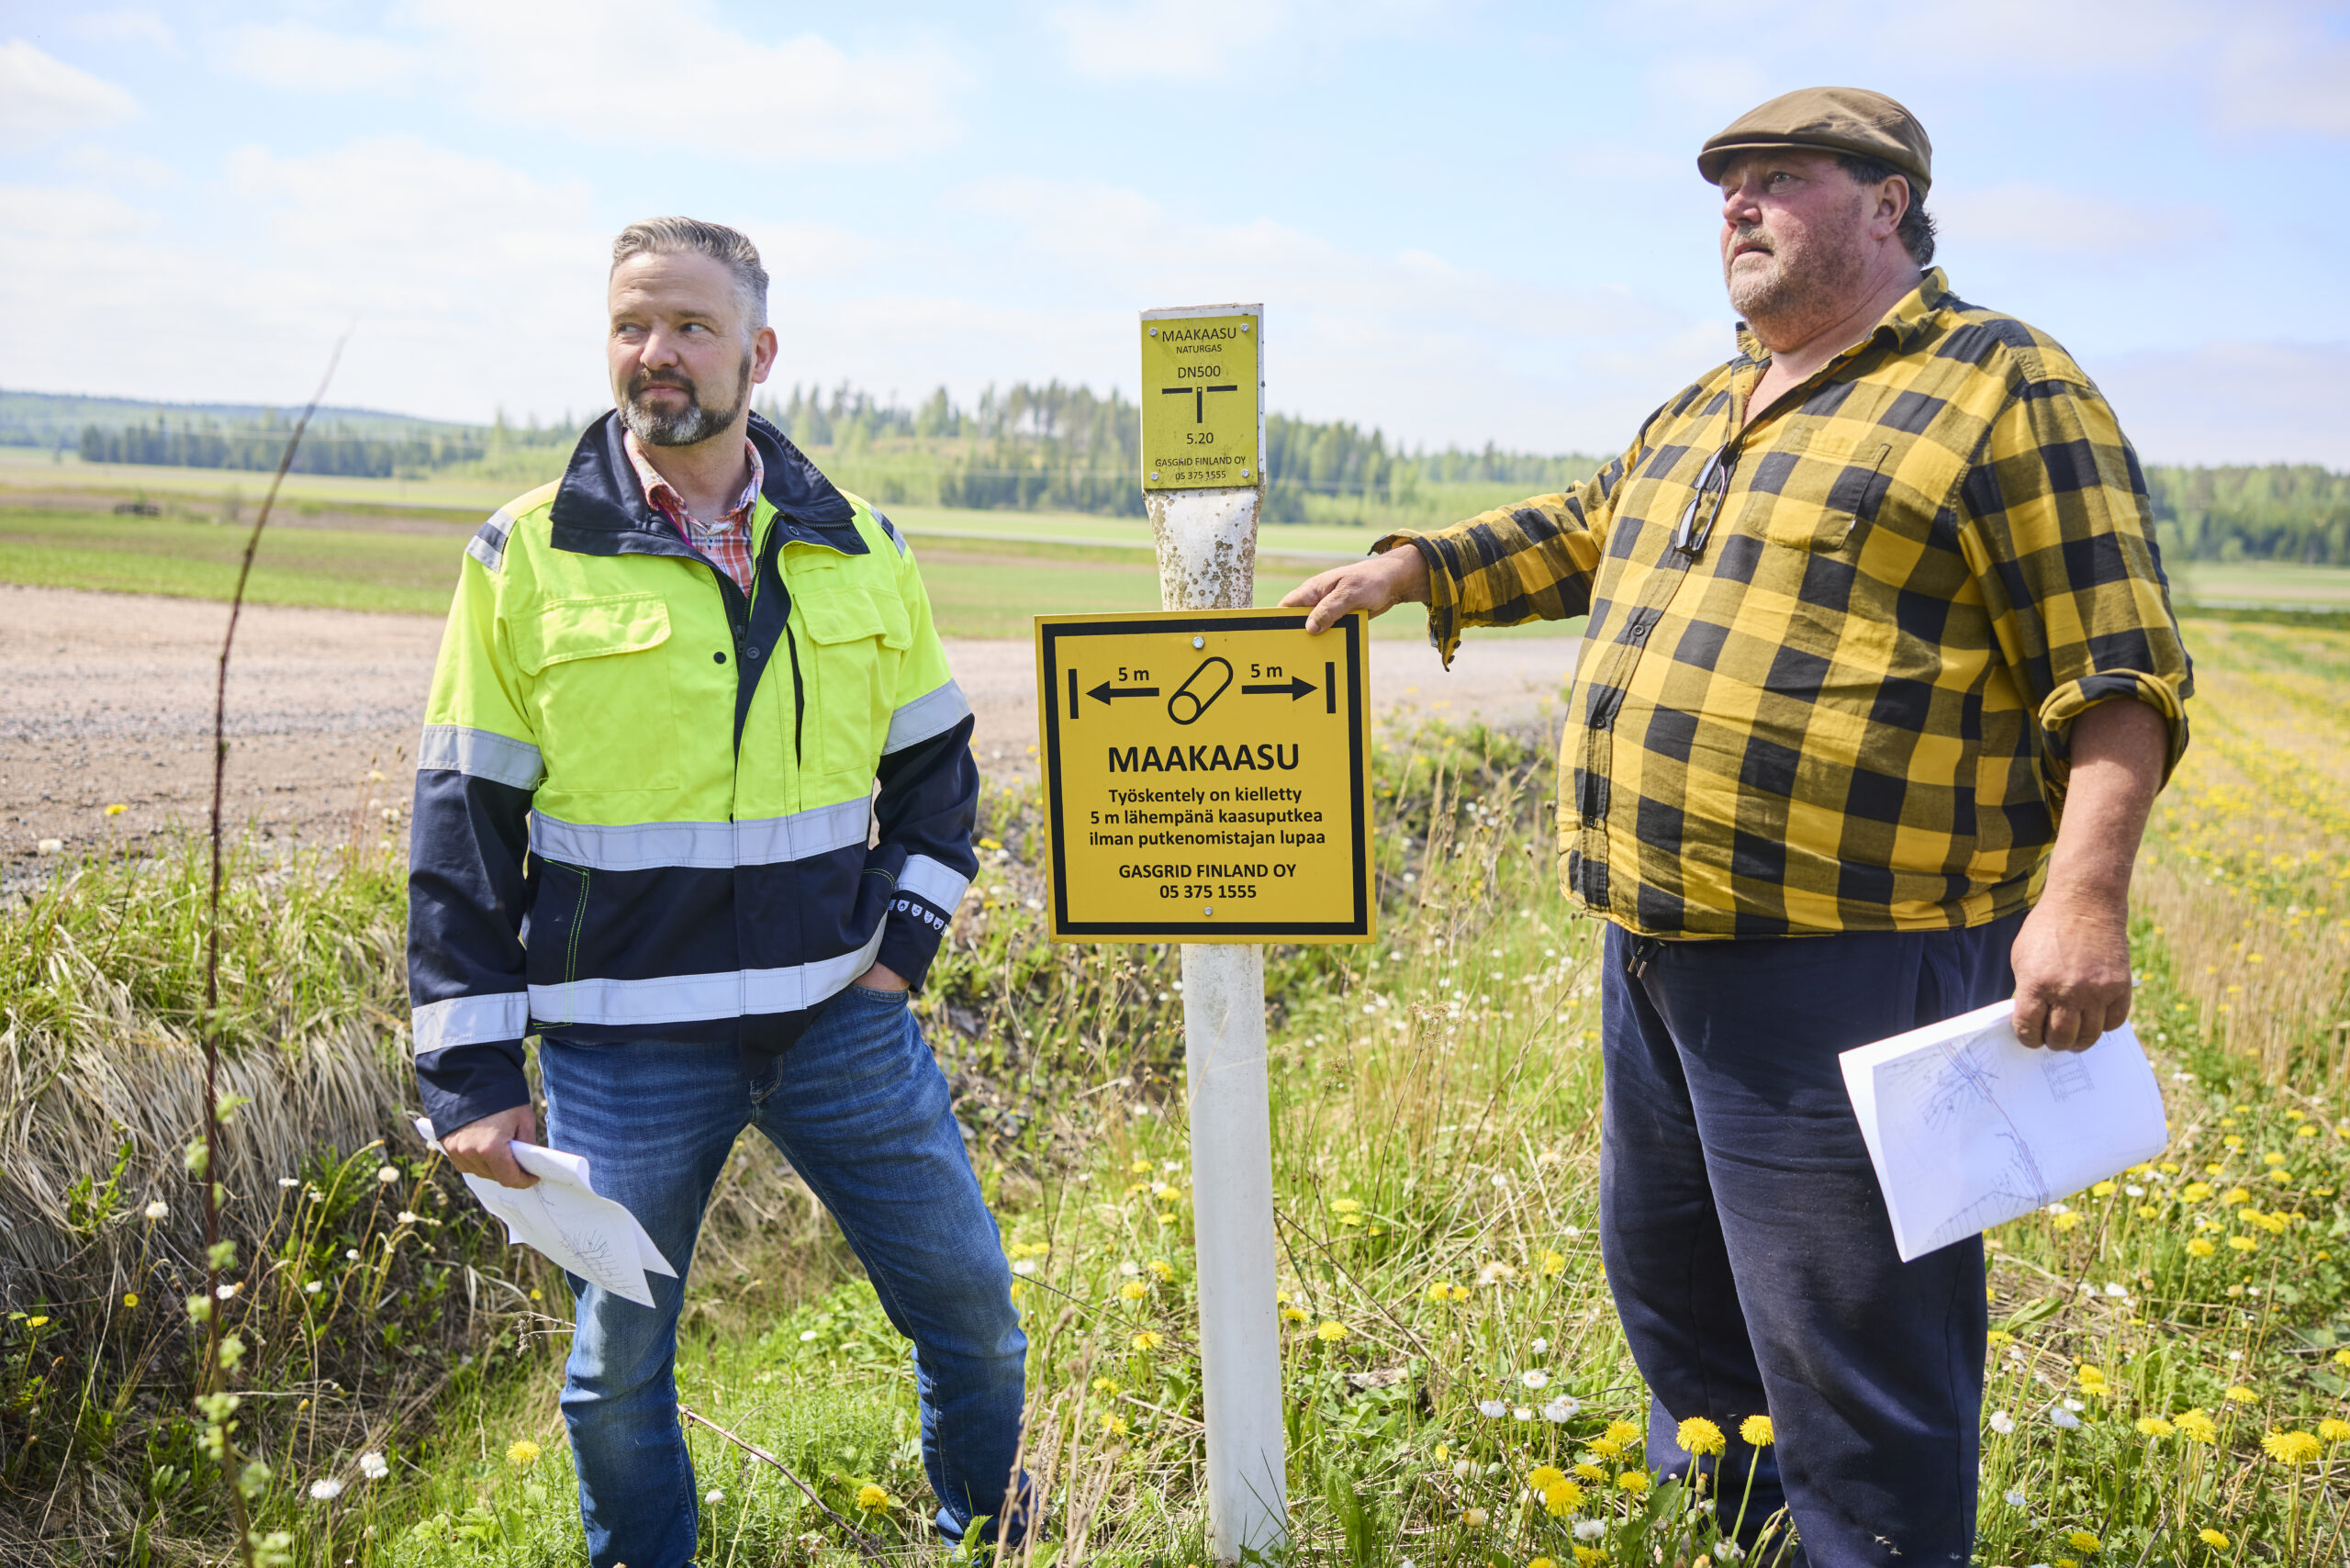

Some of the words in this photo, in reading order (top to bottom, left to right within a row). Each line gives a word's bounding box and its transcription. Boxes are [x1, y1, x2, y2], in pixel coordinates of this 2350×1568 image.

[1163, 328, 1236, 342] MAAKAASU
[1177, 344, 1222, 353] NATURGAS
[1179, 366, 1220, 378] DN500
[1187, 432, 1214, 444] 5.20
[1156, 458, 1192, 466] GASGRID
[1195, 456, 1232, 465] FINLAND
[1235, 456, 1246, 465] OY
[1176, 473, 1185, 481] 05
[1206, 471, 1226, 480] 1555
[1119, 667, 1127, 681] 5
[1134, 670, 1148, 680] m
[1251, 664, 1260, 678] 5
[1267, 666, 1282, 678] m
[1109, 744, 1298, 772] MAAKAASU
[1109, 788, 1204, 805] Työskentely
[1210, 791, 1229, 801] on
[1236, 787, 1302, 803] kielletty
[1091, 812, 1099, 823] 5
[1105, 814, 1119, 823] m
[1125, 810, 1213, 826] lähempänä
[1219, 808, 1322, 825] kaasuputkea
[1090, 832, 1133, 845] ilman
[1139, 831, 1274, 848] putkenomistajan
[1281, 830, 1325, 846] lupaa
[1119, 865, 1192, 878] GASGRID
[1197, 865, 1268, 877] FINLAND
[1273, 864, 1296, 877] OY
[1160, 885, 1179, 898] 05
[1184, 885, 1213, 898] 375
[1218, 885, 1256, 898] 1555
